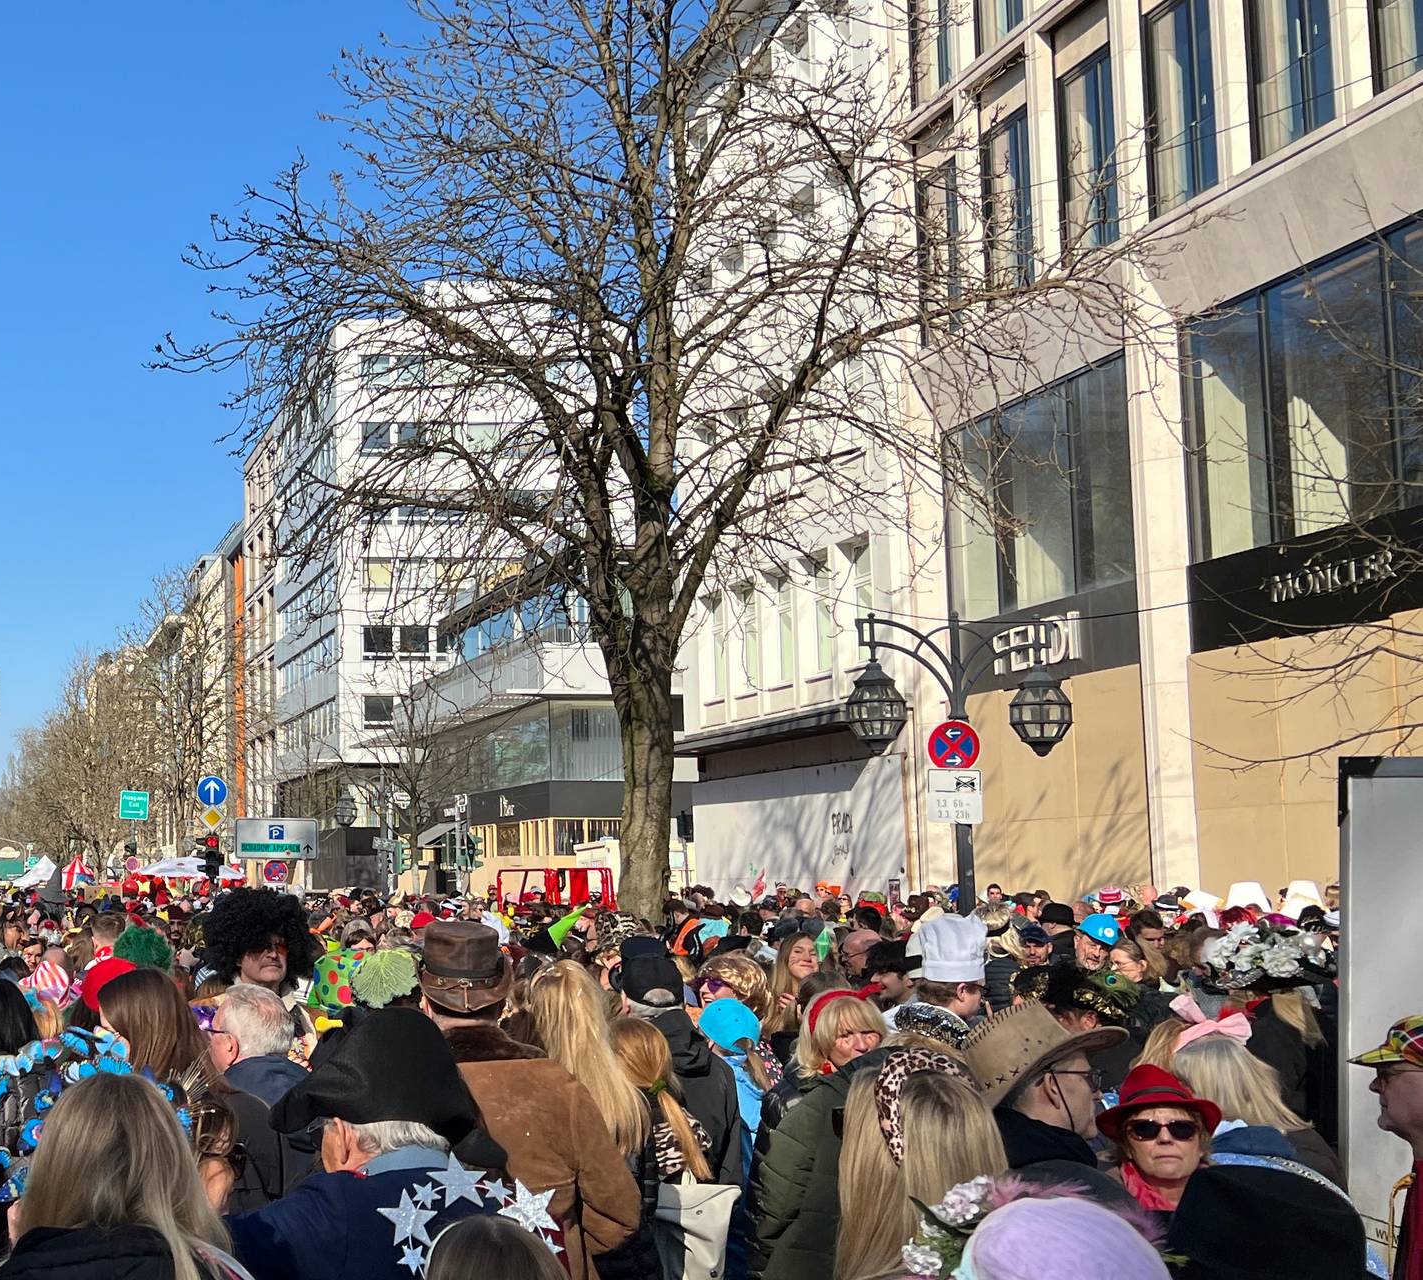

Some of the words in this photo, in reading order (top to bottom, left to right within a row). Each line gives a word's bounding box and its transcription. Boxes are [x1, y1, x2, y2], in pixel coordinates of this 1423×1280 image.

[1270, 551, 1397, 602] MONCLER
[953, 799, 963, 808] 6h
[956, 810, 970, 819] 23h
[272, 829, 280, 839] P
